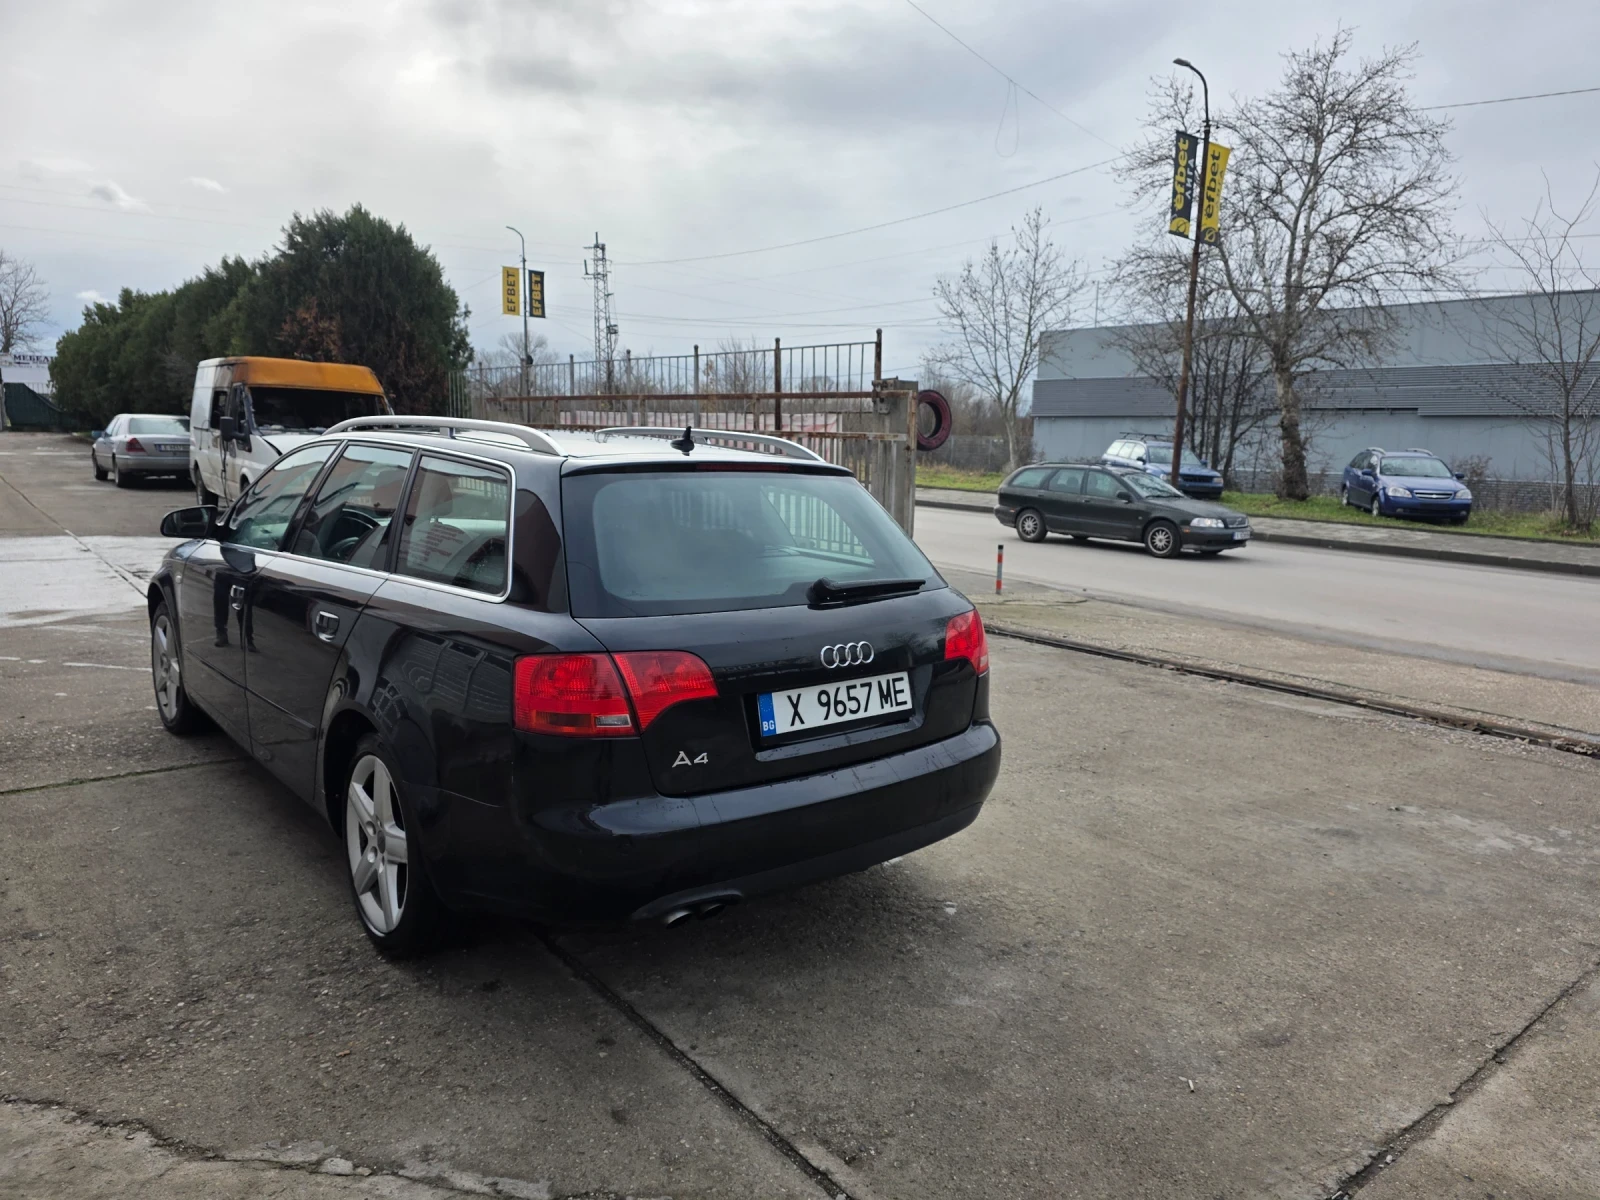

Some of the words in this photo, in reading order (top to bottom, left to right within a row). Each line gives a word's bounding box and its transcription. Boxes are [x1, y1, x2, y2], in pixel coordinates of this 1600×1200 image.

[1204, 149, 1221, 219] efbet
[506, 270, 516, 313] EFBET
[531, 273, 543, 316] EFBET
[787, 693, 805, 727] X
[817, 681, 873, 721] 9657
[877, 676, 908, 710] ME
[762, 720, 775, 731] BG
[672, 751, 708, 768] A4
